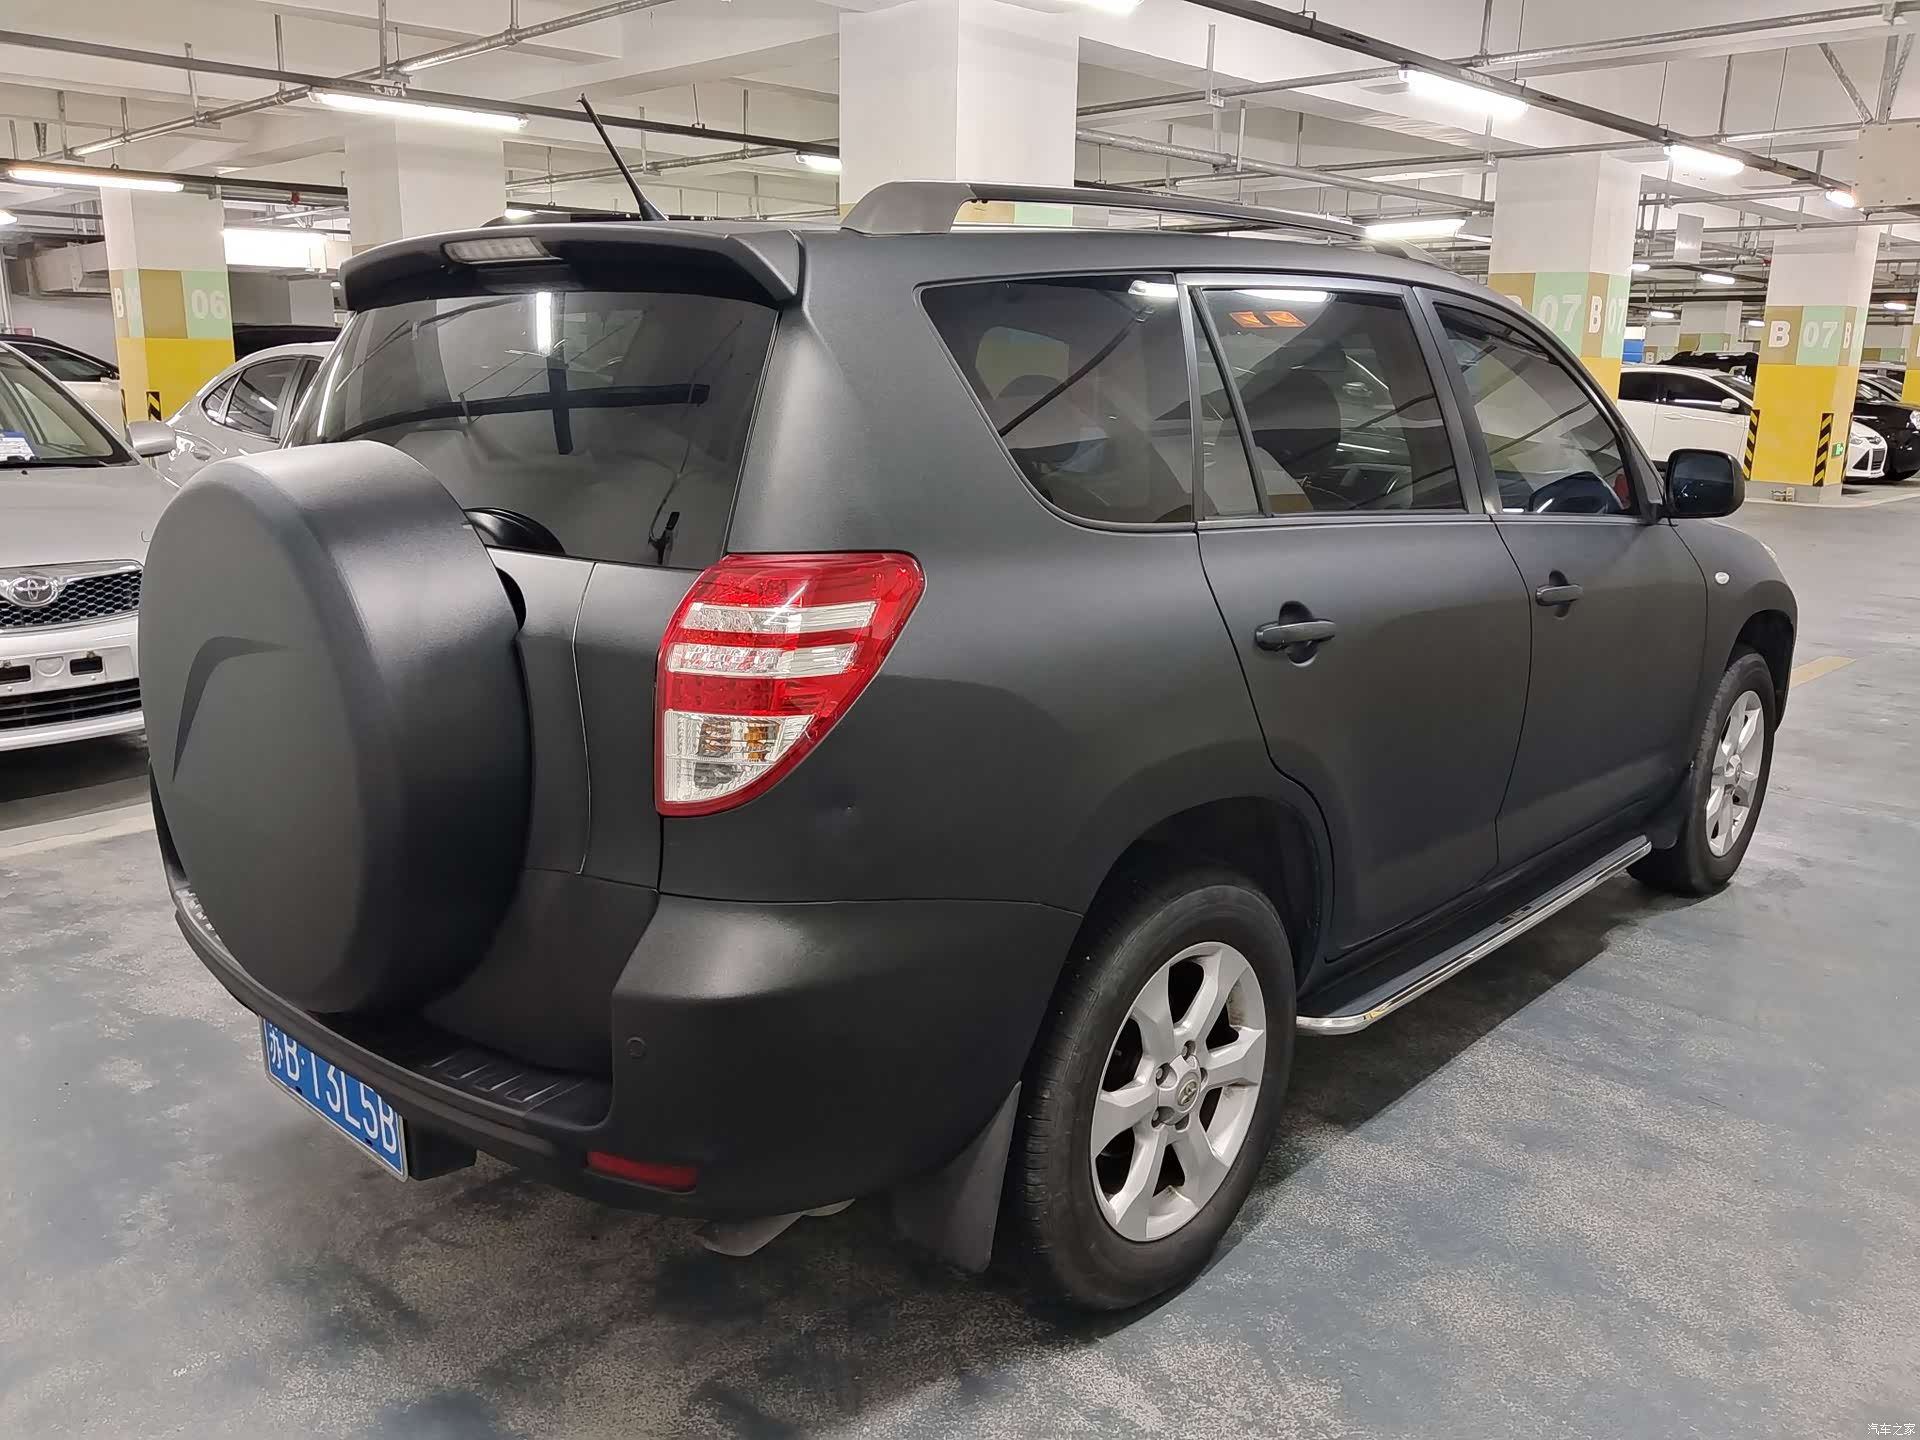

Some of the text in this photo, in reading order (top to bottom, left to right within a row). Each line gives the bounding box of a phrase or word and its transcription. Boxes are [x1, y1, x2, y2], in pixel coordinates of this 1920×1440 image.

[114, 287, 125, 319] B
[191, 288, 227, 320] 06
[1536, 294, 1583, 333] 07
[1588, 295, 1627, 334] B 07
[1768, 320, 1792, 348] B
[1803, 321, 1839, 349] 07
